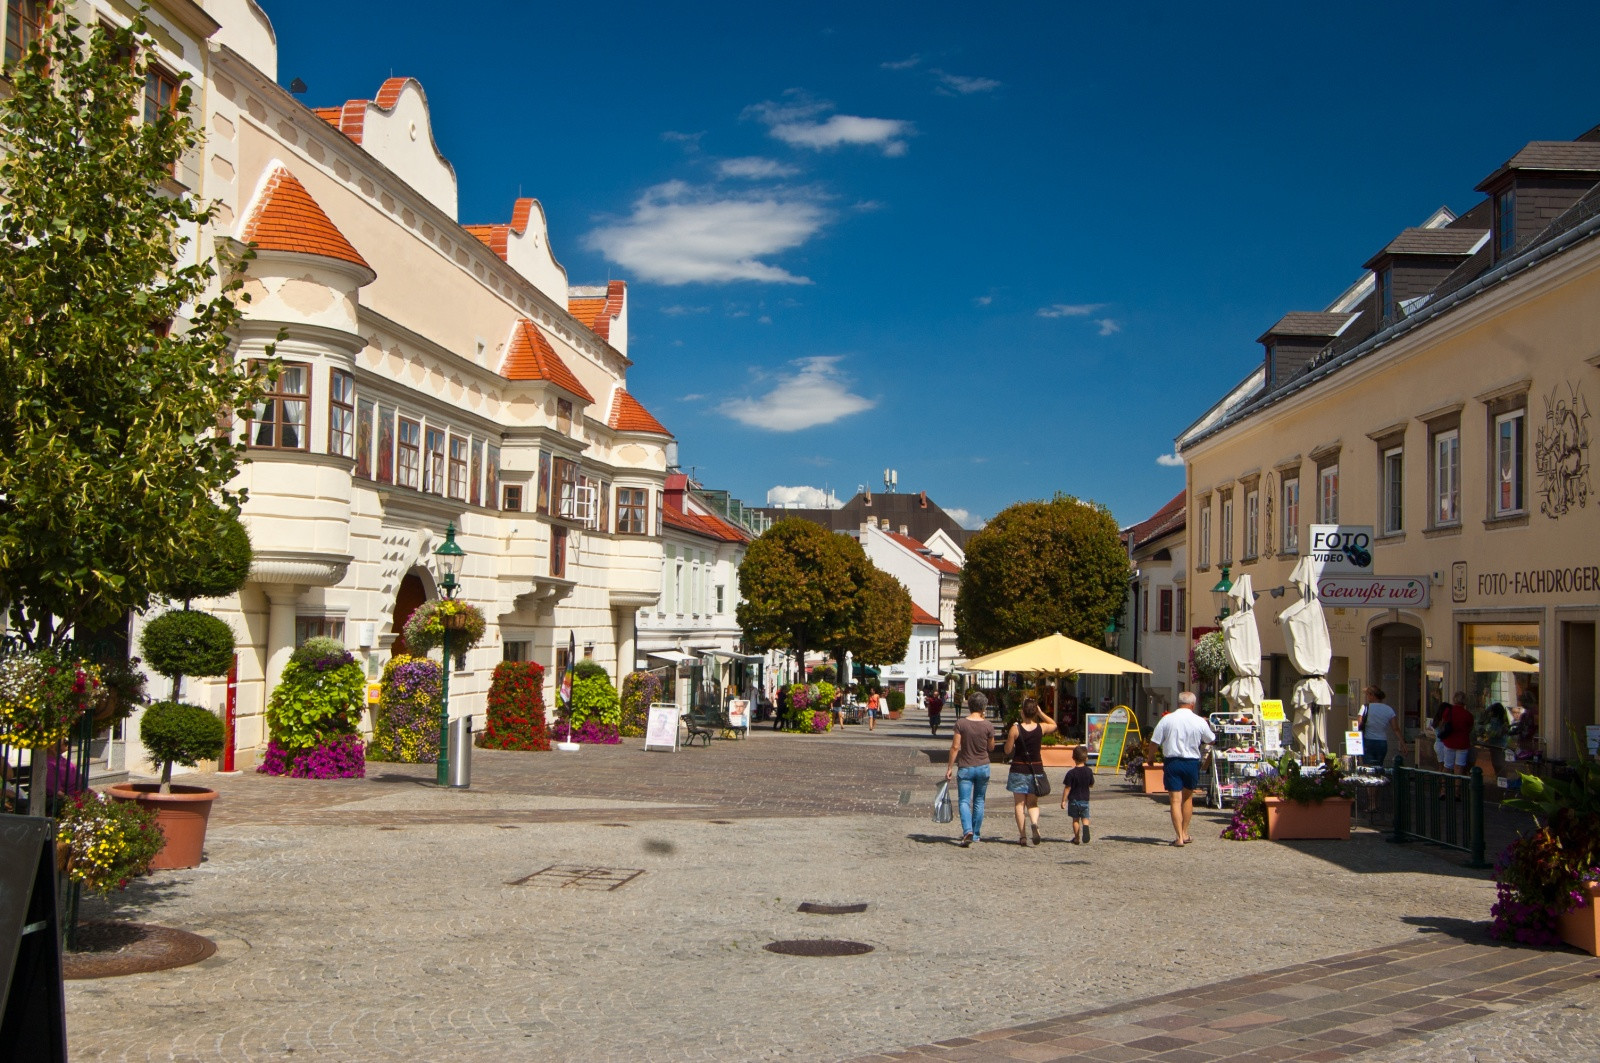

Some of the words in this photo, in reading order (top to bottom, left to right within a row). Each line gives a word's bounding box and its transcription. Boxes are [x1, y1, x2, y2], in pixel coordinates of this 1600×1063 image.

[1314, 532, 1370, 549] FOTO
[1314, 554, 1344, 563] VIDEO
[1321, 582, 1386, 605] Gewußt
[1389, 587, 1418, 599] wie
[1496, 632, 1510, 642] Foto
